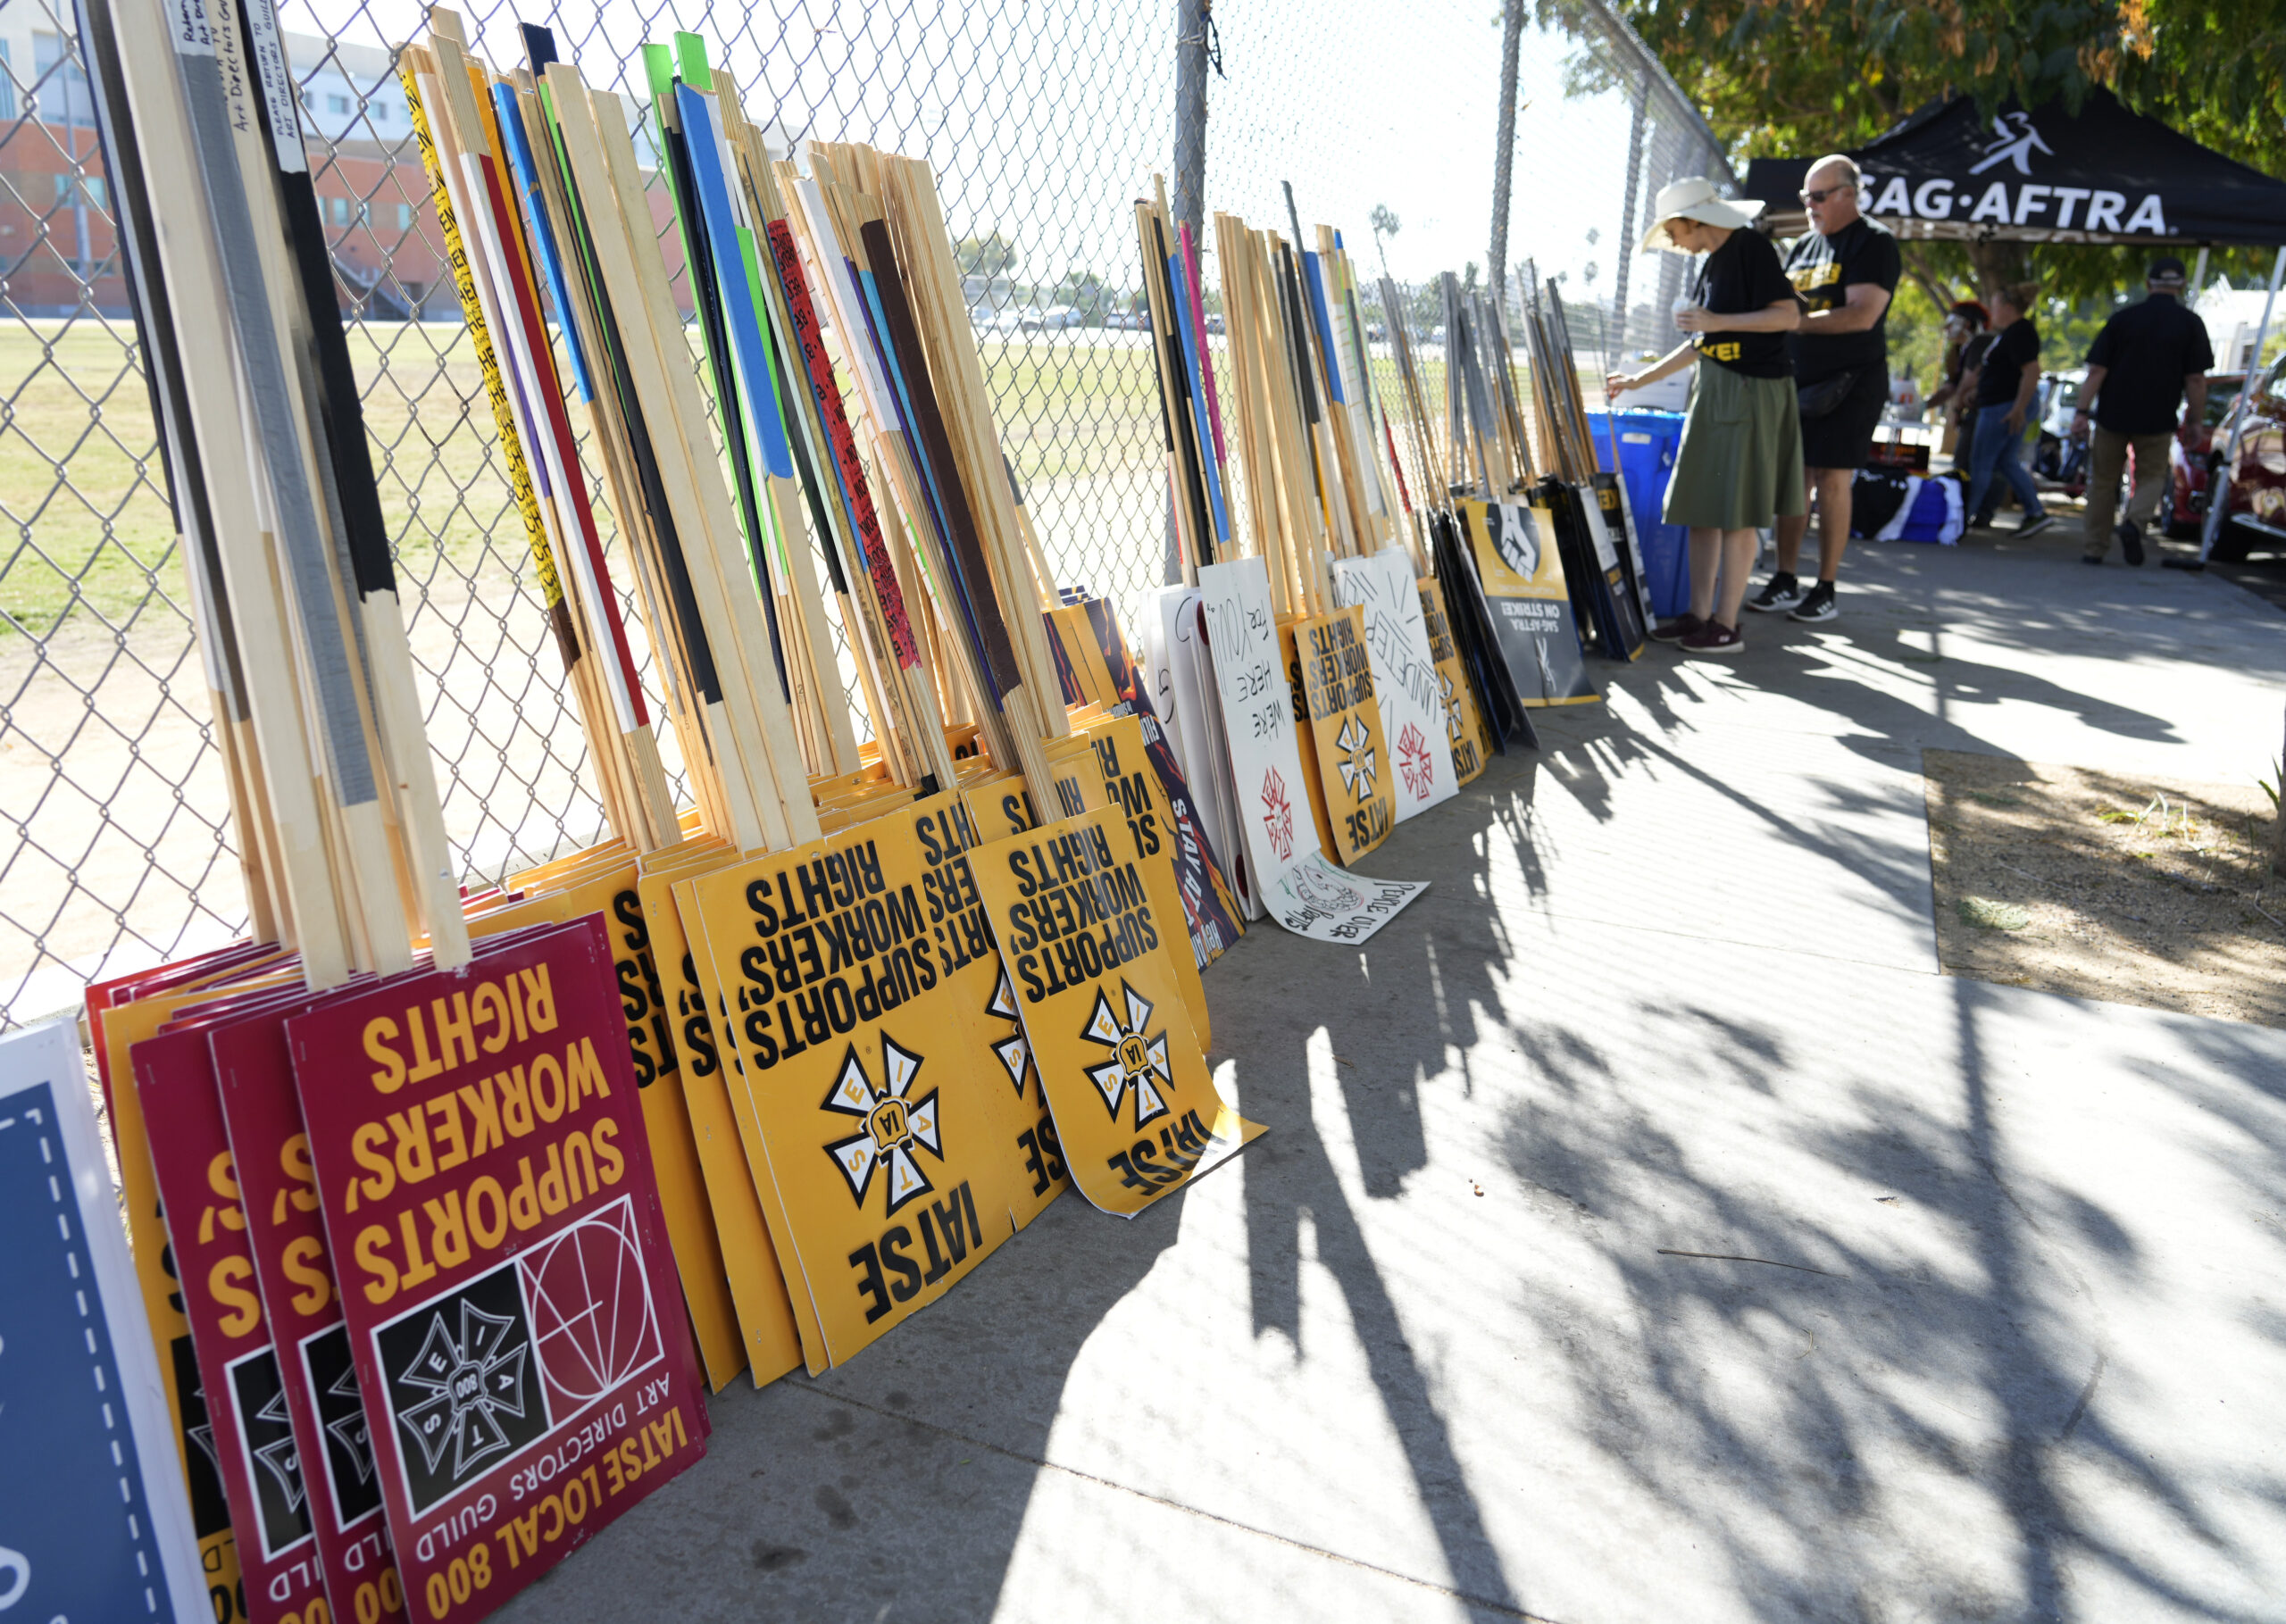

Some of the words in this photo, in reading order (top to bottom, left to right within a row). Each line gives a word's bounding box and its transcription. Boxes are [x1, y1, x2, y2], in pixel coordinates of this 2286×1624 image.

[254, 23, 264, 37] TO
[260, 46, 272, 87] RETURN
[271, 42, 288, 106] DIRECTORS
[233, 104, 249, 132] Art
[271, 97, 284, 136] PLEASE
[285, 119, 296, 138] ART
[1309, 617, 1356, 657] RIGHTS
[1544, 604, 1561, 619] ON
[1237, 659, 1273, 703] HERE
[1309, 670, 1373, 721] SUPPORTS
[1451, 740, 1481, 780] IATS
[1172, 798, 1202, 875] STAY
[1346, 796, 1389, 853] IATSE
[746, 839, 887, 938] RIGHTS
[1008, 824, 1115, 897] RIGHTS
[1184, 867, 1202, 913] AT
[1009, 862, 1147, 956] WORKERS'
[1366, 882, 1416, 914] PEOPLE
[738, 884, 927, 1012] WORKERS'
[1016, 906, 1159, 1004] SUPPORTS
[1200, 920, 1223, 954] Hey
[362, 962, 560, 1095] RIGHTS
[745, 937, 938, 1070] SUPPORTS
[344, 1036, 613, 1215] WORKERS'
[354, 1117, 625, 1305] SUPPORTS
[847, 1179, 983, 1325] IATSE
[636, 1371, 671, 1416] ART
[510, 1402, 628, 1502] DIRECTORS
[601, 1405, 689, 1497] IATSE
[414, 1493, 498, 1563] GUILD
[496, 1463, 604, 1570] LOCAL
[425, 1542, 493, 1620] 800
